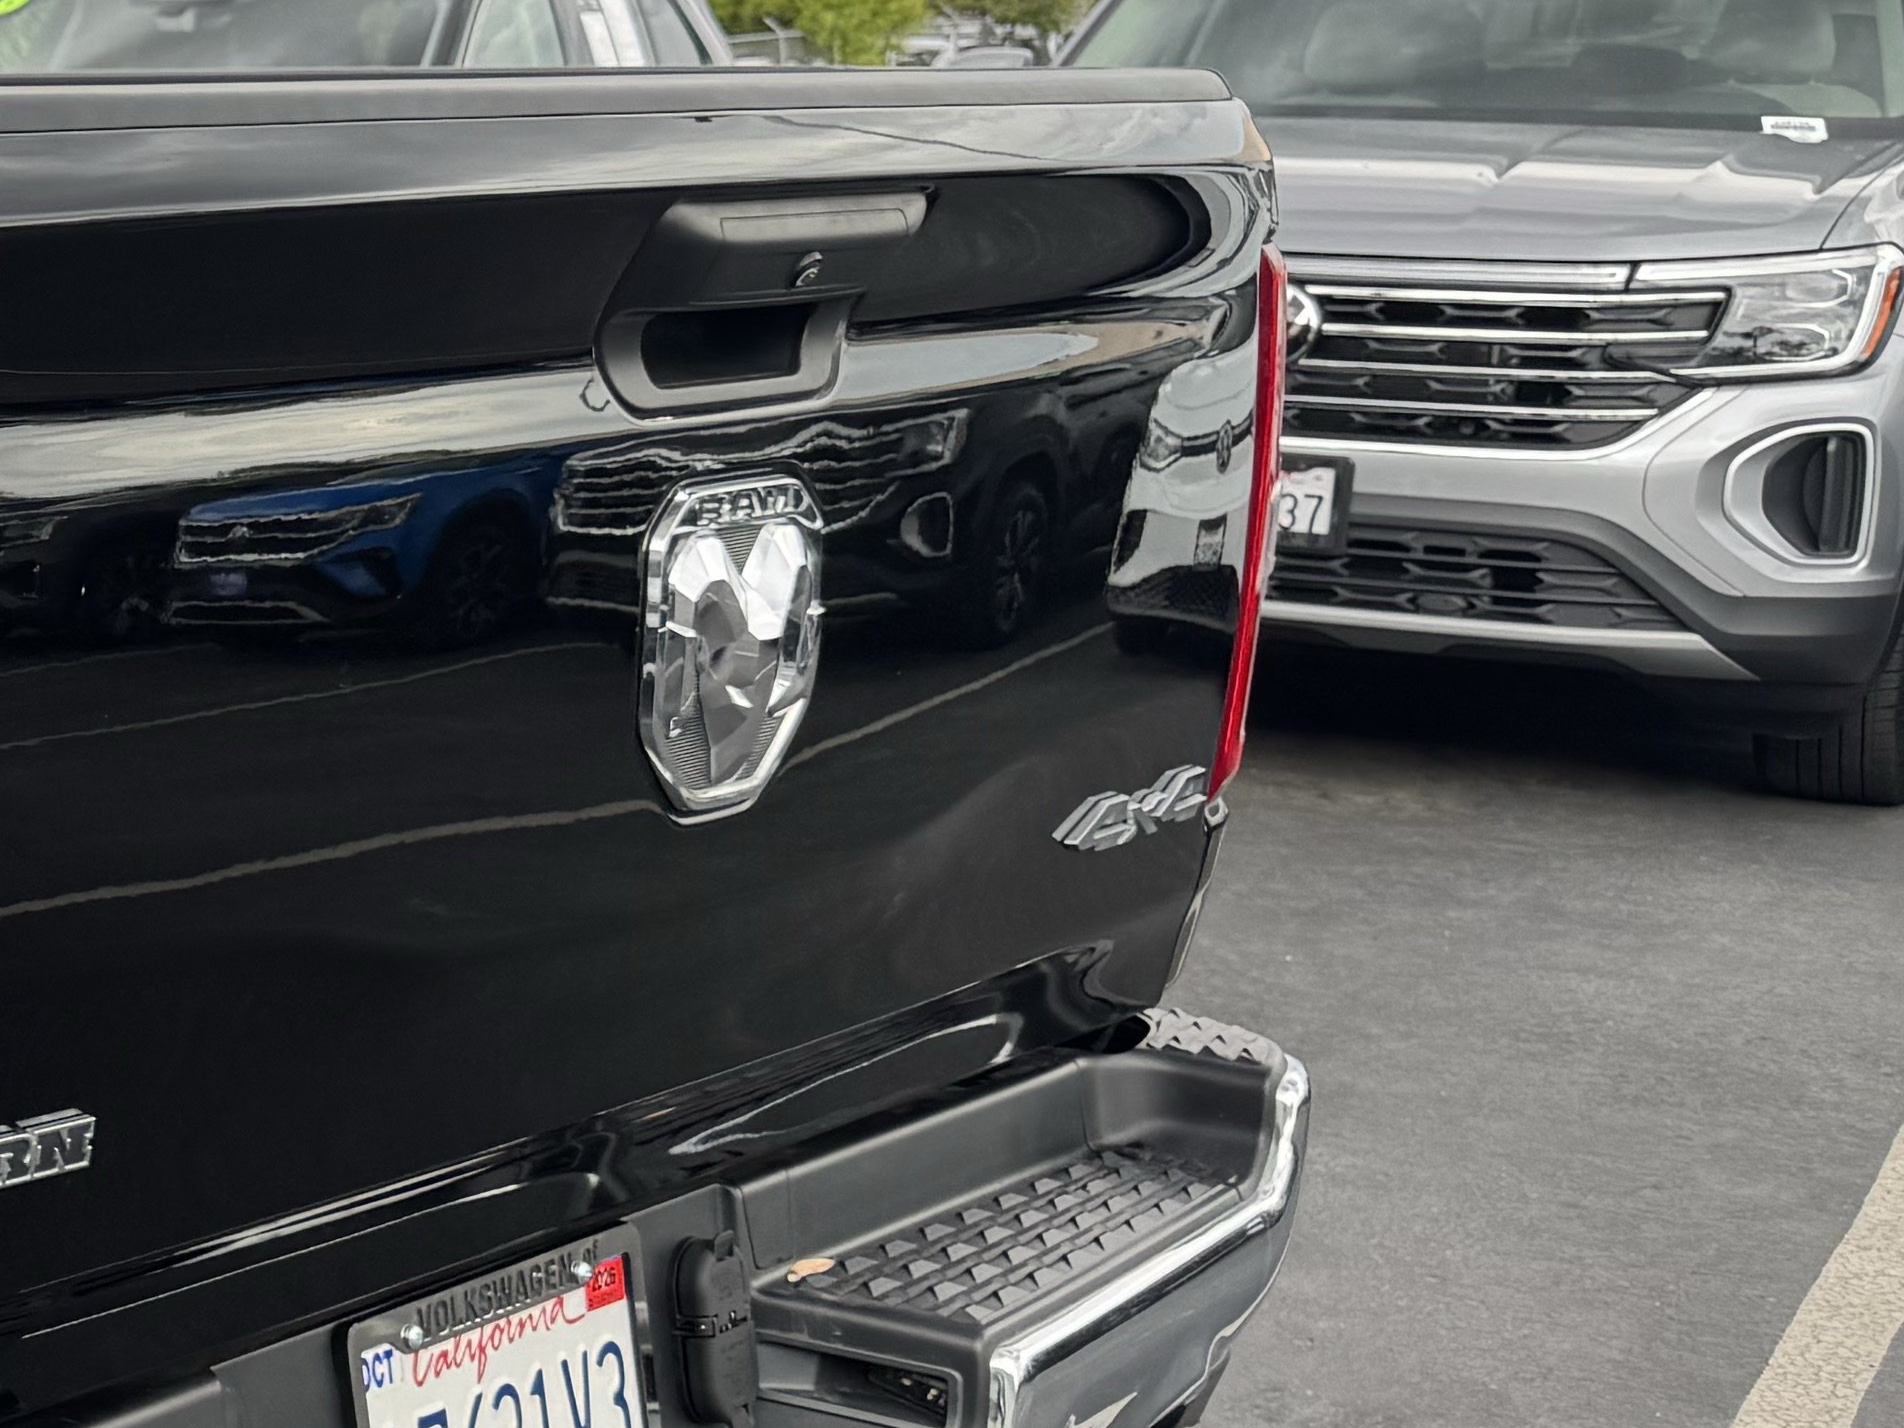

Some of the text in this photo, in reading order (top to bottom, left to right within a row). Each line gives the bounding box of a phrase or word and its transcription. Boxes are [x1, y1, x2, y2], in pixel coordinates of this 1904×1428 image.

[696, 486, 805, 527] RAM
[416, 1250, 572, 1337] VOLKSWAGEN
[411, 1295, 586, 1387] California
